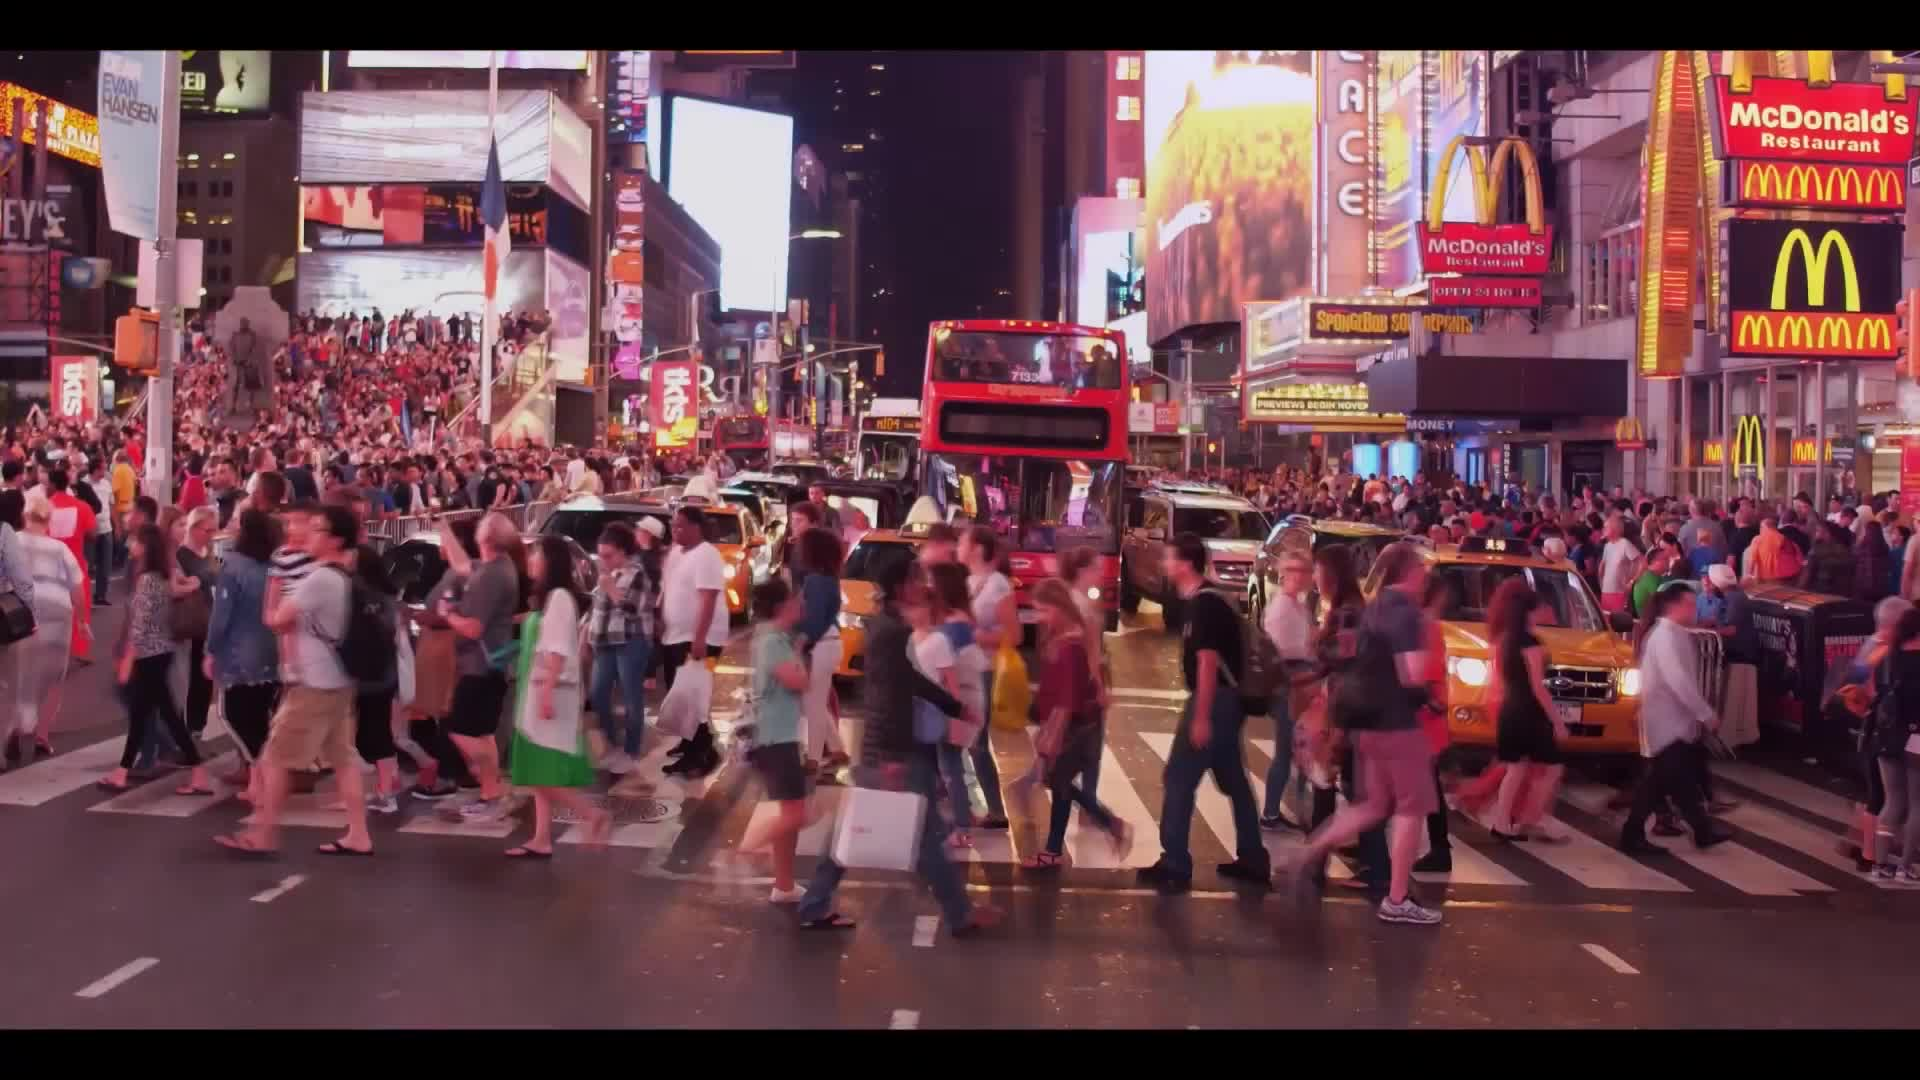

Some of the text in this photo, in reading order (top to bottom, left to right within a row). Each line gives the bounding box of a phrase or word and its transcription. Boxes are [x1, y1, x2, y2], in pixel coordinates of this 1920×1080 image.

[103, 72, 138, 98] EVAN
[103, 94, 158, 125] HANSEN
[1730, 102, 1910, 135] McDonald's
[1338, 51, 1365, 216] ACE
[1761, 132, 1880, 153] Restaurant
[0, 199, 66, 240] EY'S
[1427, 238, 1545, 256] McDonald's
[1446, 256, 1524, 268] Restaurant
[1435, 287, 1471, 297] OPEN
[664, 366, 691, 423] tkts
[1257, 399, 1305, 410] PREVIEWS
[1307, 399, 1336, 410] BEGIN
[1406, 419, 1455, 431] MONEY
